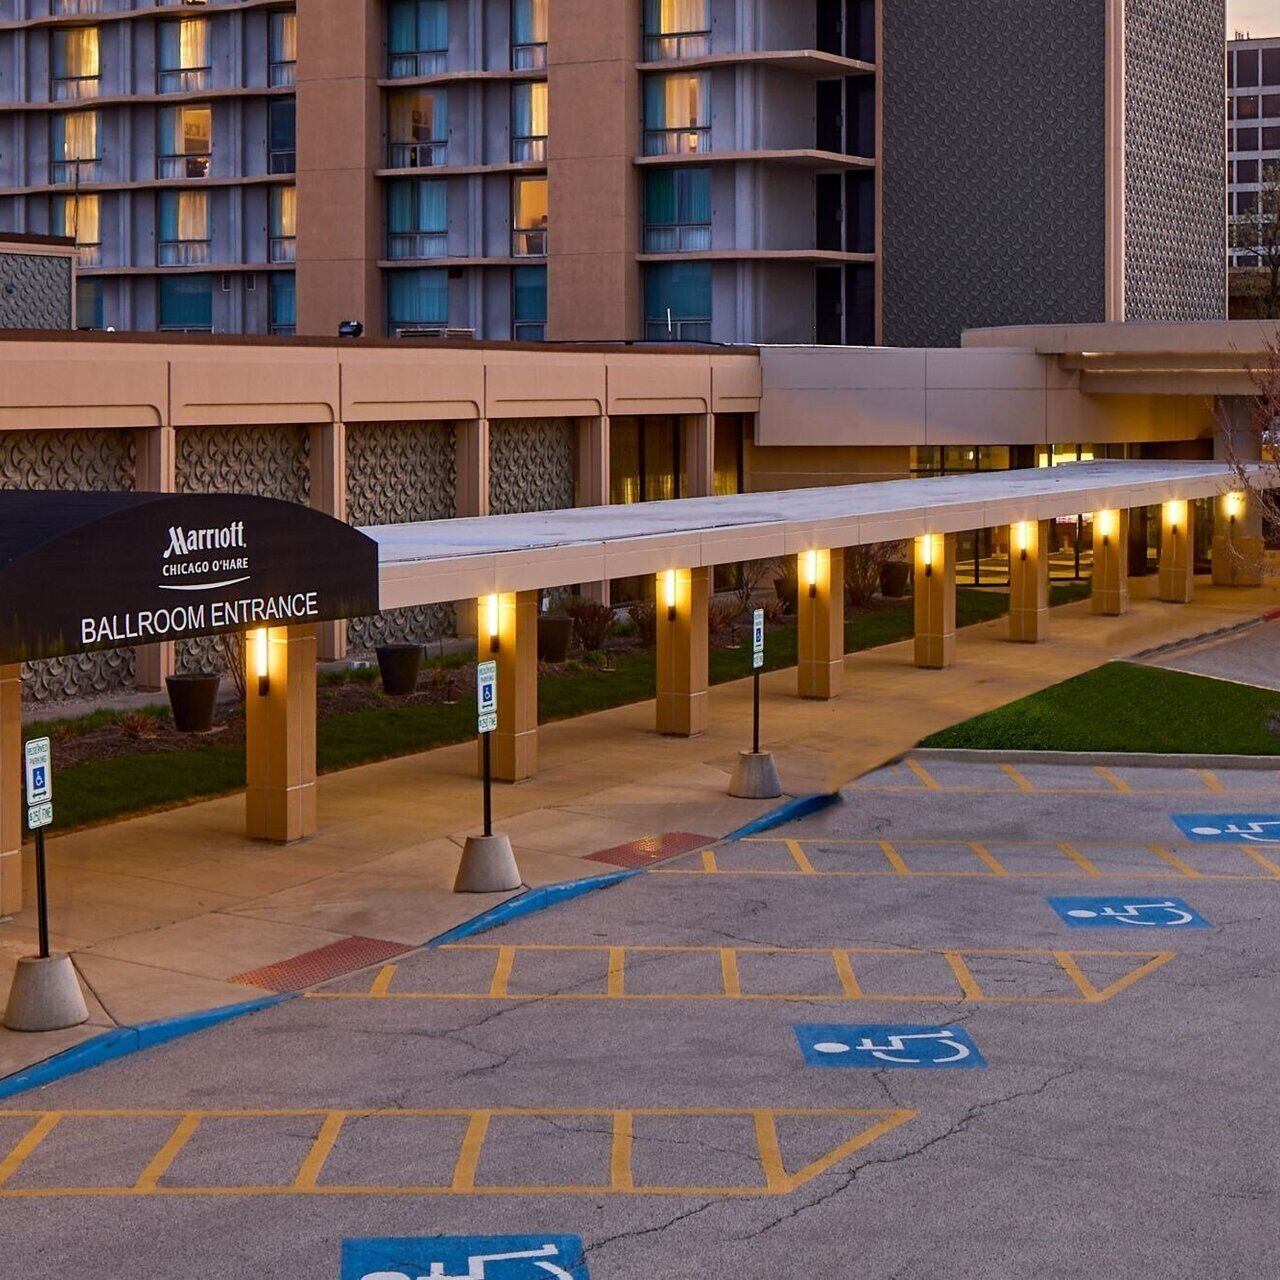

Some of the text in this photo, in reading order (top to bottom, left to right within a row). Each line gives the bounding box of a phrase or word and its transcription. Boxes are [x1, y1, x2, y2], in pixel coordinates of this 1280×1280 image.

[163, 520, 245, 558] Marriott
[162, 557, 249, 577] CHICAGO O'HARE
[81, 591, 319, 644] BALLROOM ENTRANCE
